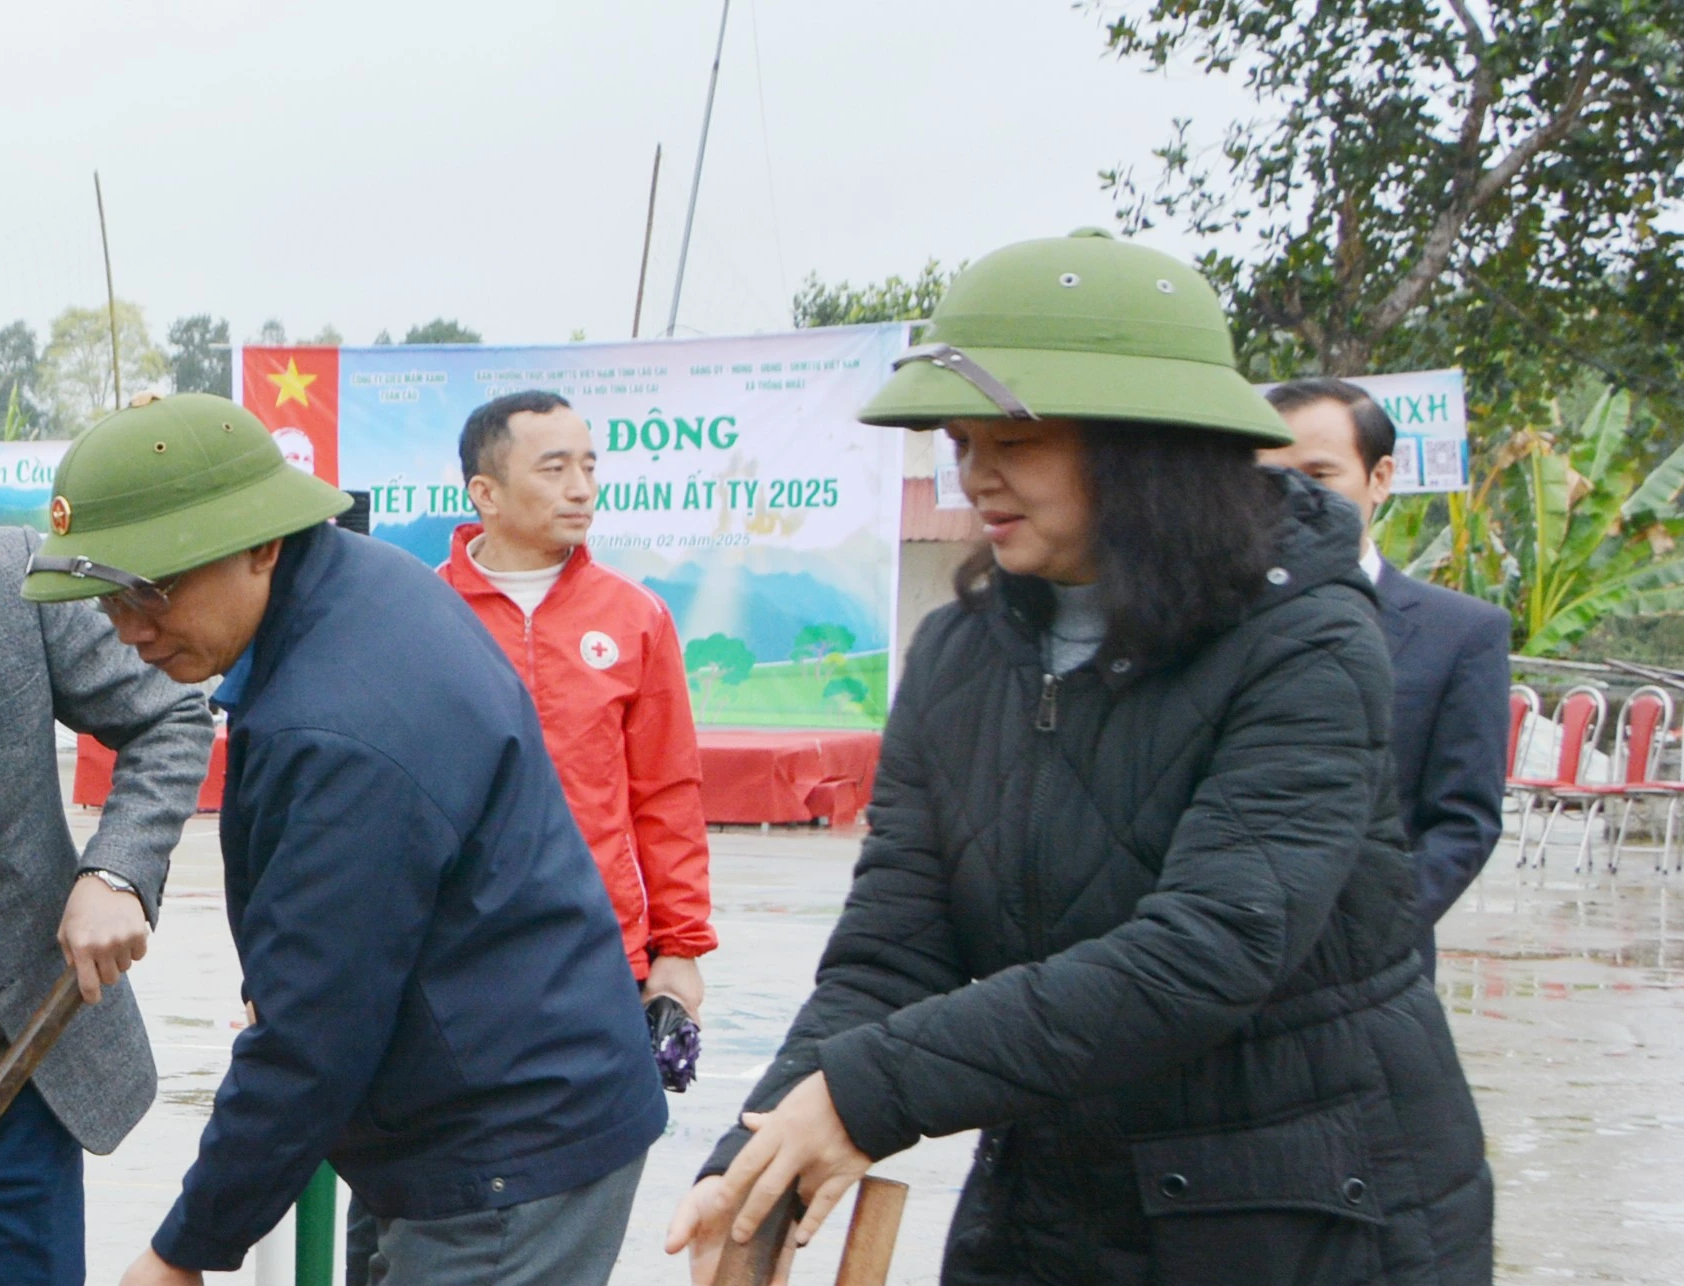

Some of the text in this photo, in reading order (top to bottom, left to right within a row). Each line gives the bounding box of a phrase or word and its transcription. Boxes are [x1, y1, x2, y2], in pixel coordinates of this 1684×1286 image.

[606, 406, 739, 461] ĐỘNG
[371, 474, 417, 512] TẾT
[594, 469, 838, 516] XUÂN ẤT TỴ 2025
[656, 534, 674, 547] 02
[678, 534, 710, 547] năm
[716, 532, 751, 546] 2025
